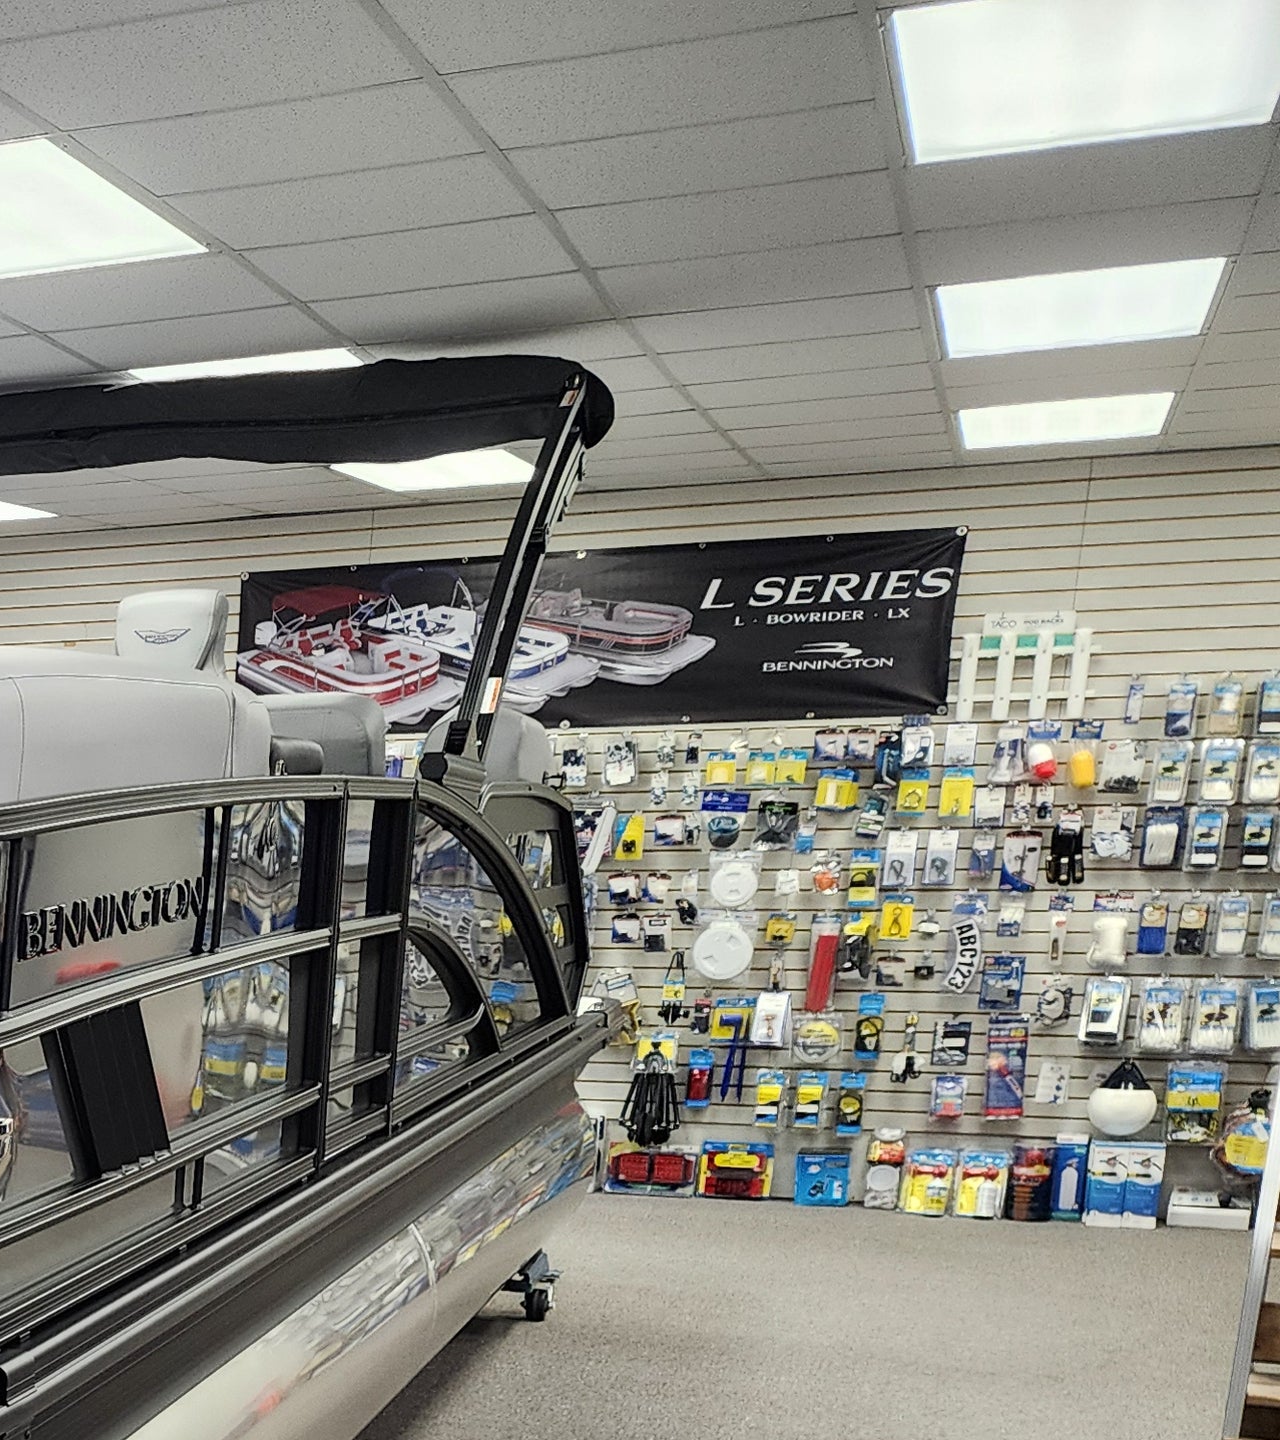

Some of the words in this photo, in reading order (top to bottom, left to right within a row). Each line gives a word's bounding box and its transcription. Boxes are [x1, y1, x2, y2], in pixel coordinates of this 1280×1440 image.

[699, 578, 735, 610] L
[748, 567, 955, 607] SERIES
[733, 616, 745, 627] L
[766, 609, 865, 626] BOWRIDER
[887, 607, 911, 619] LX
[991, 619, 1017, 629] TACO
[762, 657, 894, 673] BENNINGTON
[17, 876, 204, 962] BENNINGTON
[947, 923, 978, 989] ABC123
